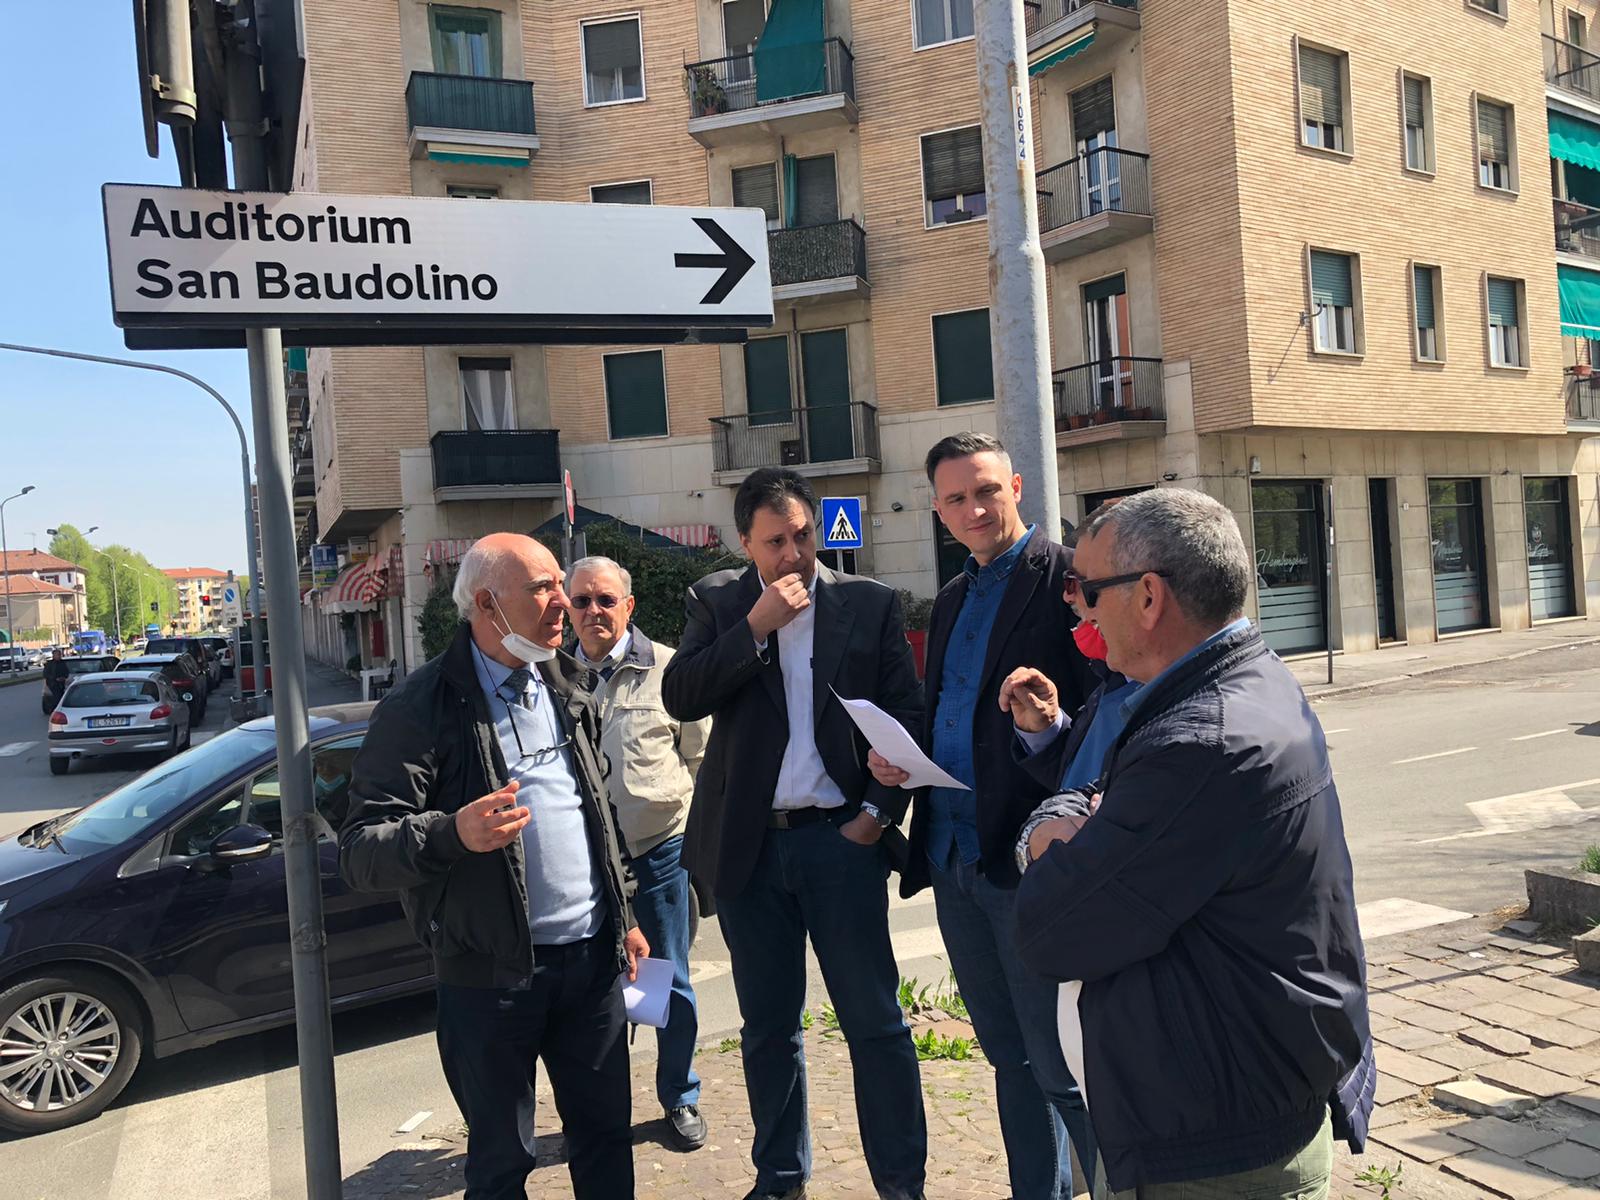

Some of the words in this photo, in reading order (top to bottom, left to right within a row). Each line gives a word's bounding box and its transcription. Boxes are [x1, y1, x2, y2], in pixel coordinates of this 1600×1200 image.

[1016, 92, 1025, 159] 10644
[130, 198, 412, 245] Auditorium
[135, 258, 240, 300] San
[255, 261, 499, 302] Baudolino
